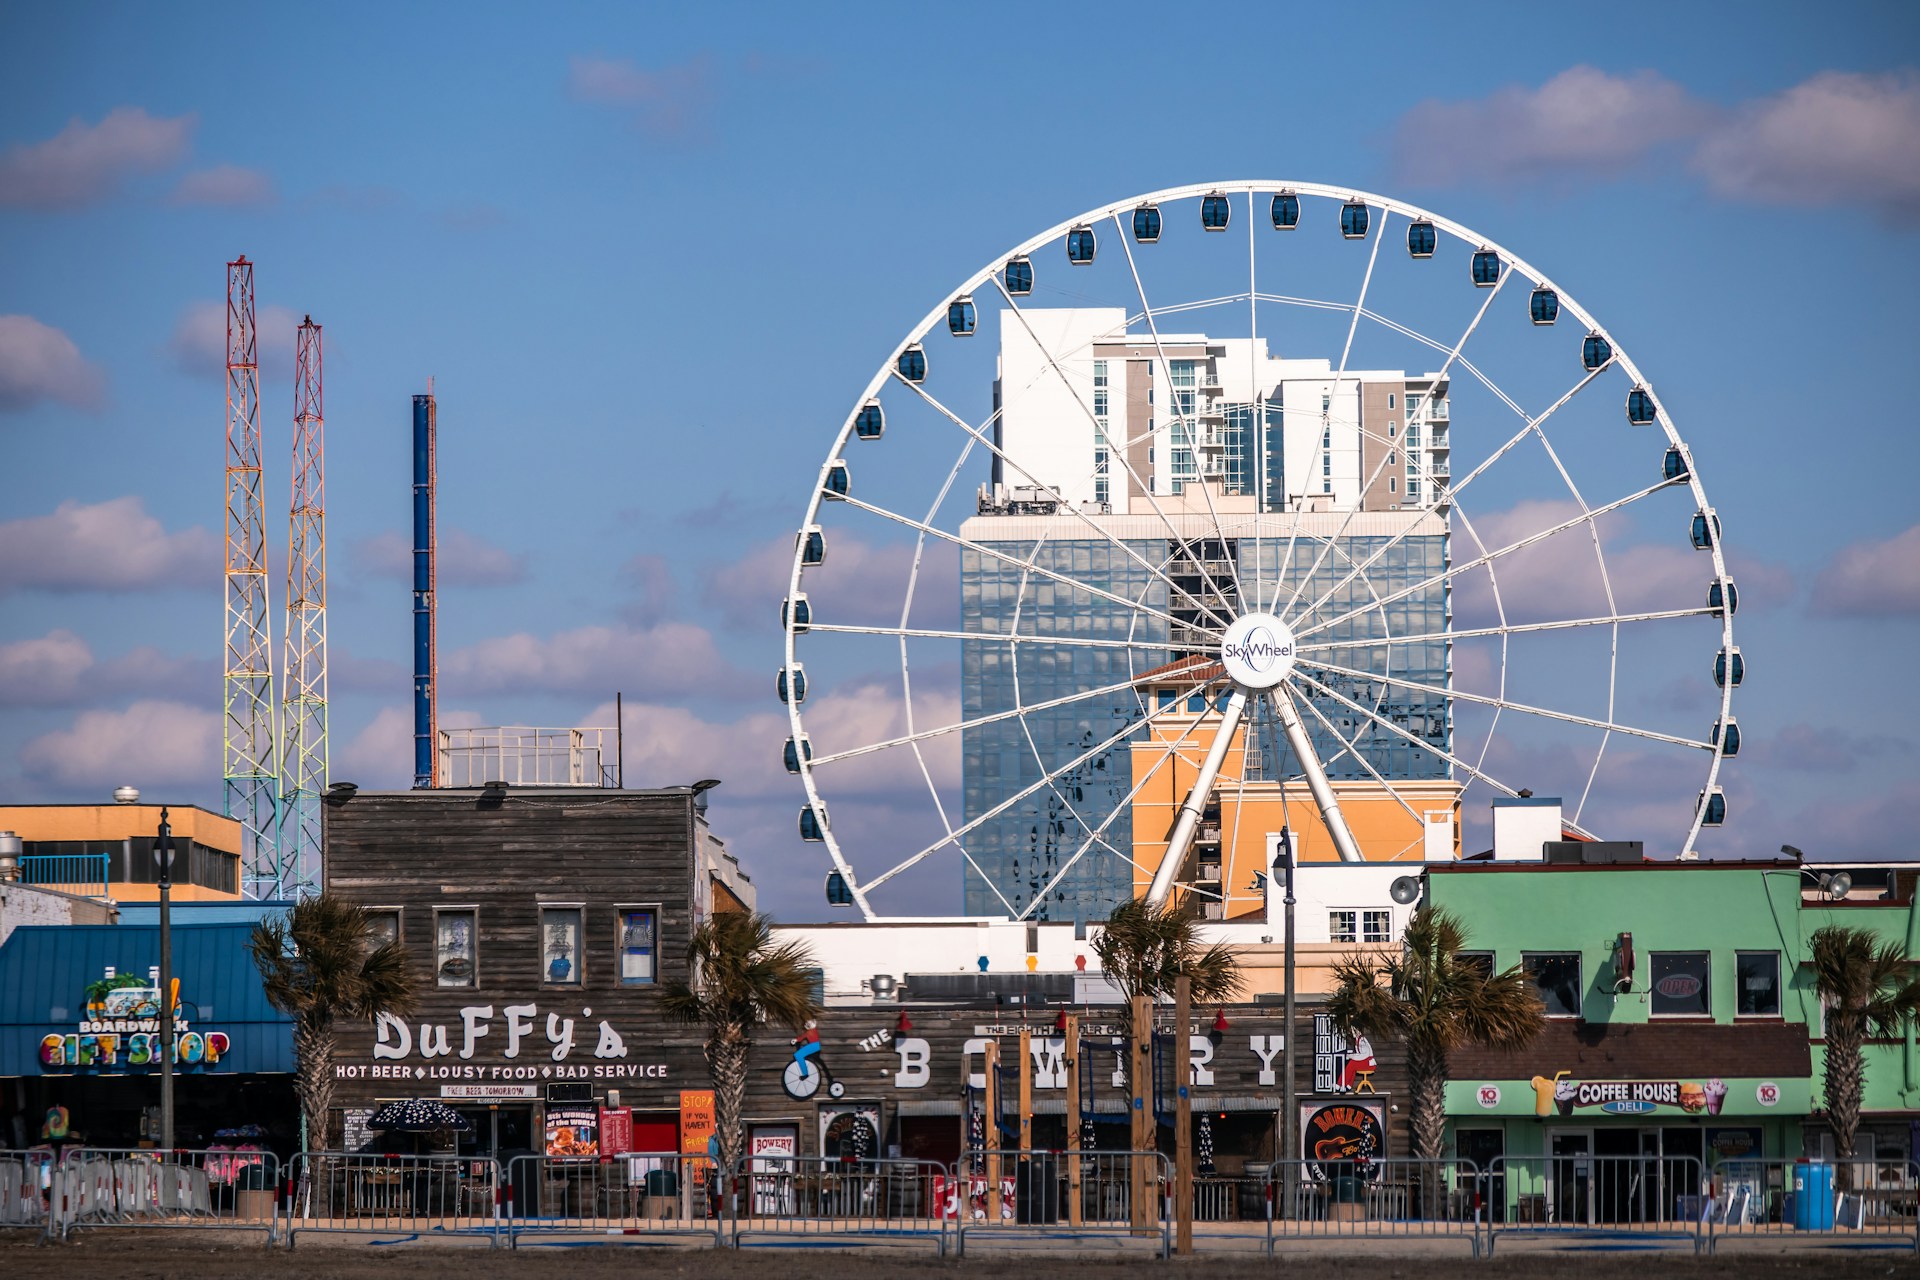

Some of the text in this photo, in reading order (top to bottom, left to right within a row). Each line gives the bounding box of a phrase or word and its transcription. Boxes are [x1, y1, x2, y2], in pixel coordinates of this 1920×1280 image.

[1225, 643, 1292, 661] SkyWheel
[1661, 979, 1698, 995] OPEN
[859, 1027, 892, 1052] THE
[40, 1033, 121, 1066] GIFT
[336, 1064, 668, 1080] HOT BEER LOUSY FOOD BAD SERVICE
[447, 1086, 463, 1096] FREE
[466, 1086, 482, 1096] BEER
[1481, 1089, 1497, 1100] 10
[1580, 1083, 1678, 1103] COFFEE HOUSE
[1761, 1087, 1776, 1098] 10
[684, 1095, 713, 1108] STOP!
[1617, 1101, 1643, 1112] DELI
[562, 1111, 596, 1120] WONDER
[570, 1119, 597, 1127] WORLD
[685, 1120, 710, 1130] HAVEN'T
[757, 1138, 793, 1153] BOWERY
